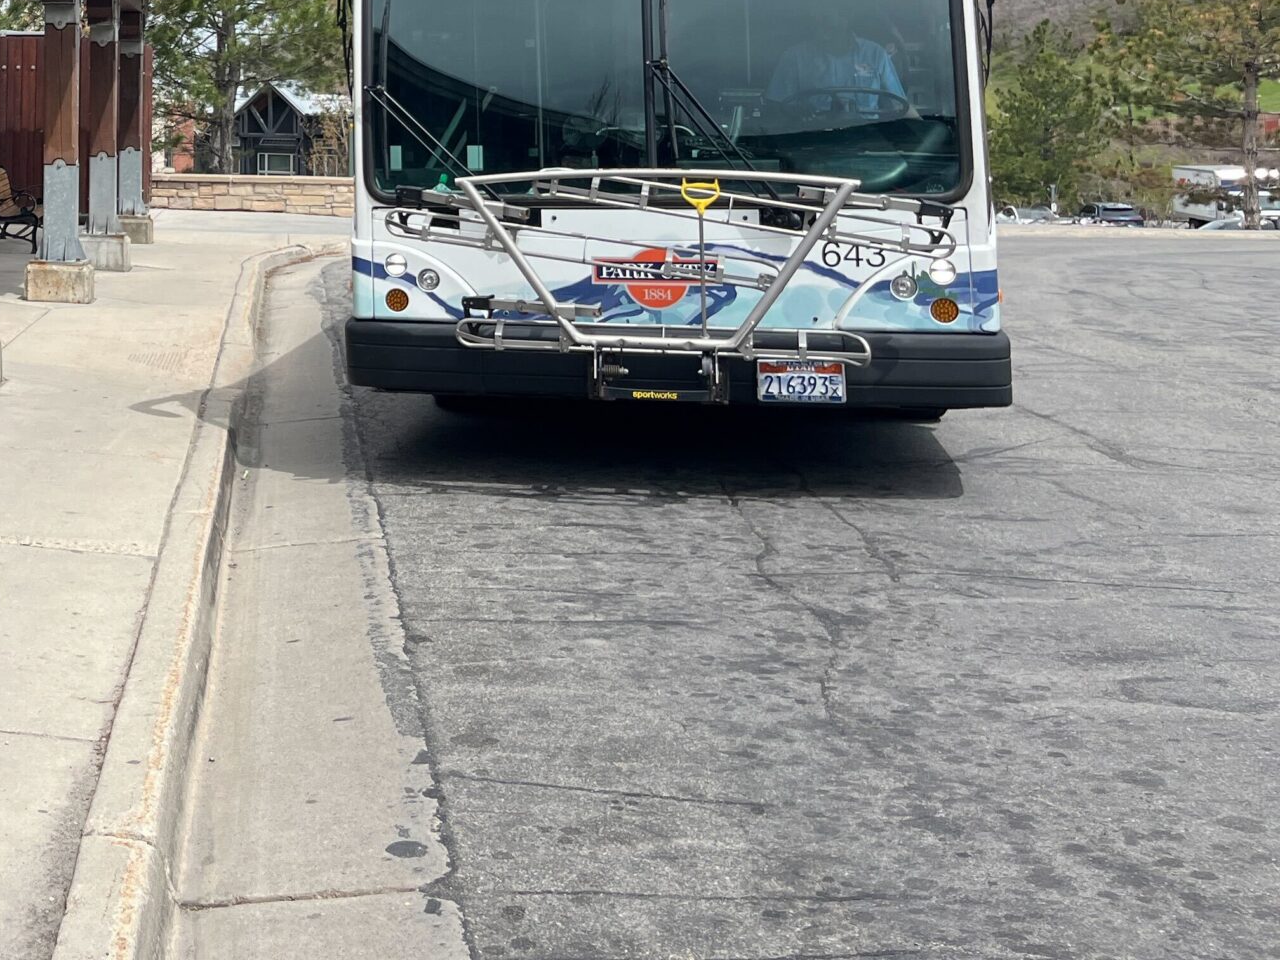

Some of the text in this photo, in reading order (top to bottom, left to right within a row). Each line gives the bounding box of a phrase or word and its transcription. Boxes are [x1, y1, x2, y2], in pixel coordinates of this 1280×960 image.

[822, 241, 886, 268] 643
[600, 263, 655, 279] PARK
[643, 288, 672, 301] 1884
[764, 375, 829, 395] 216393
[632, 390, 678, 400] sportworks
